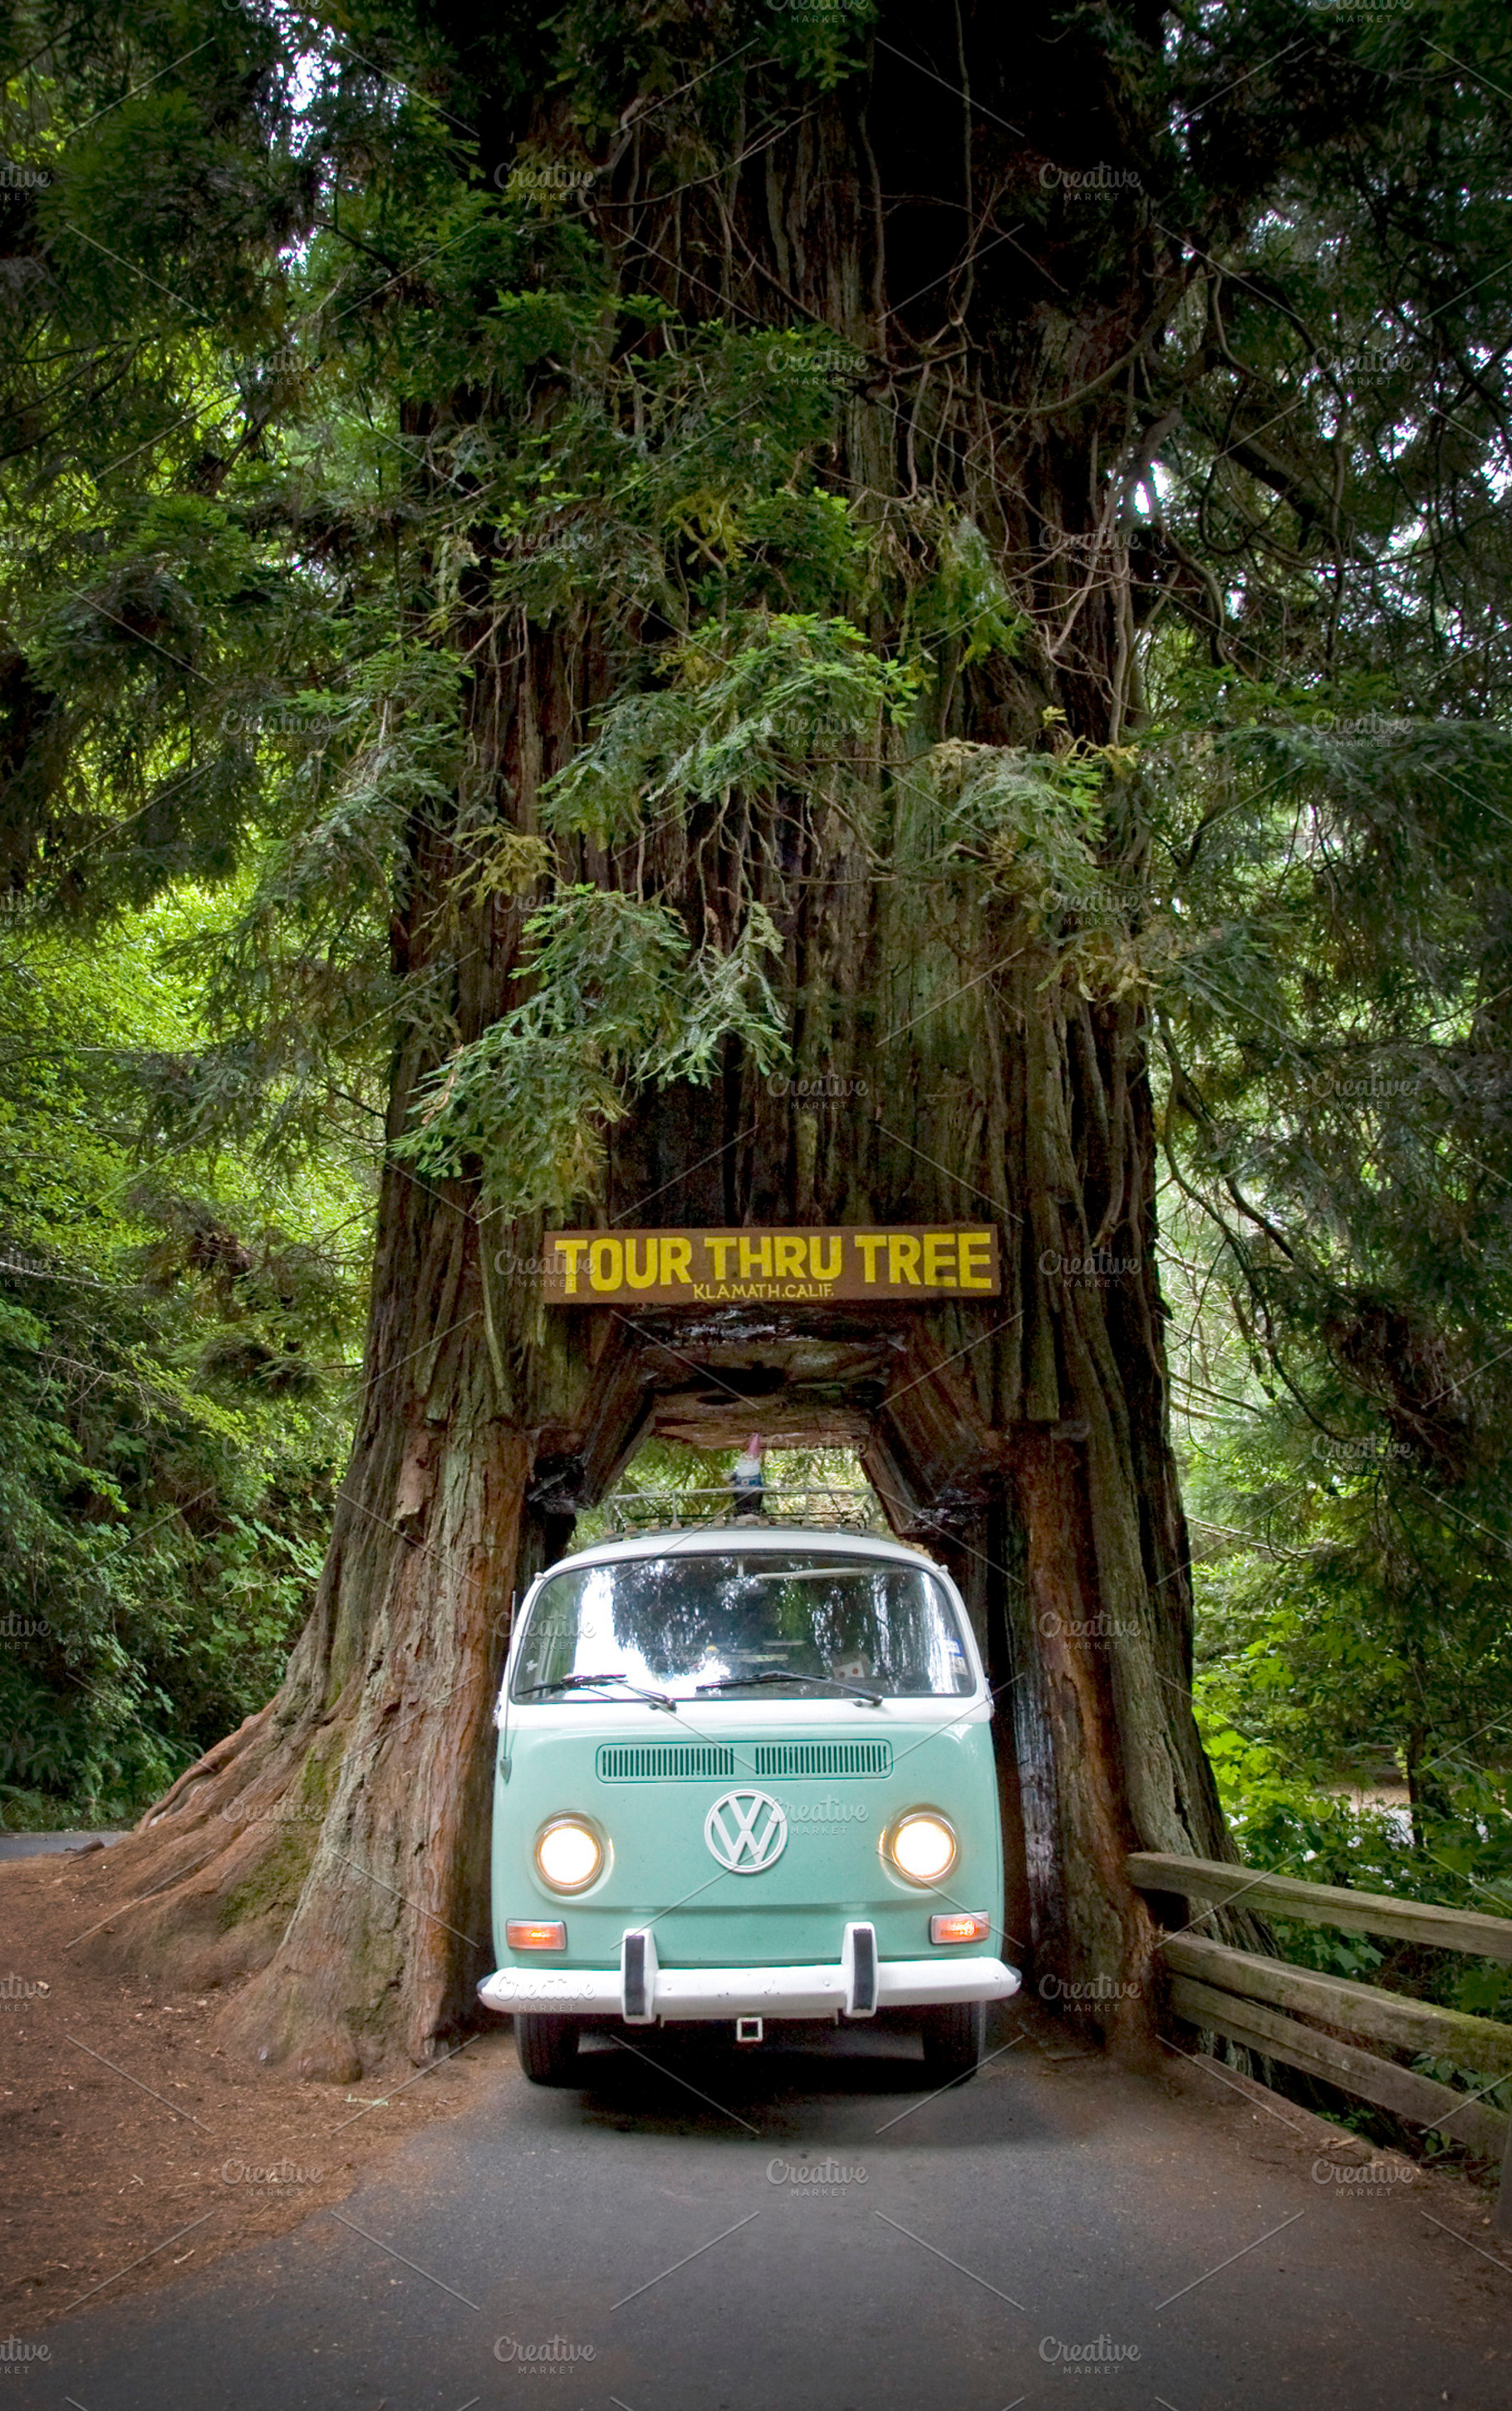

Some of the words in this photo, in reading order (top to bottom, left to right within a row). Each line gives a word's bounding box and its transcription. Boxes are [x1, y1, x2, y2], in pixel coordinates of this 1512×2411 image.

[555, 1238, 692, 1294] TOUR
[704, 1235, 842, 1280] THRU
[855, 1233, 992, 1288] TREE
[704, 1789, 788, 1873] VW
